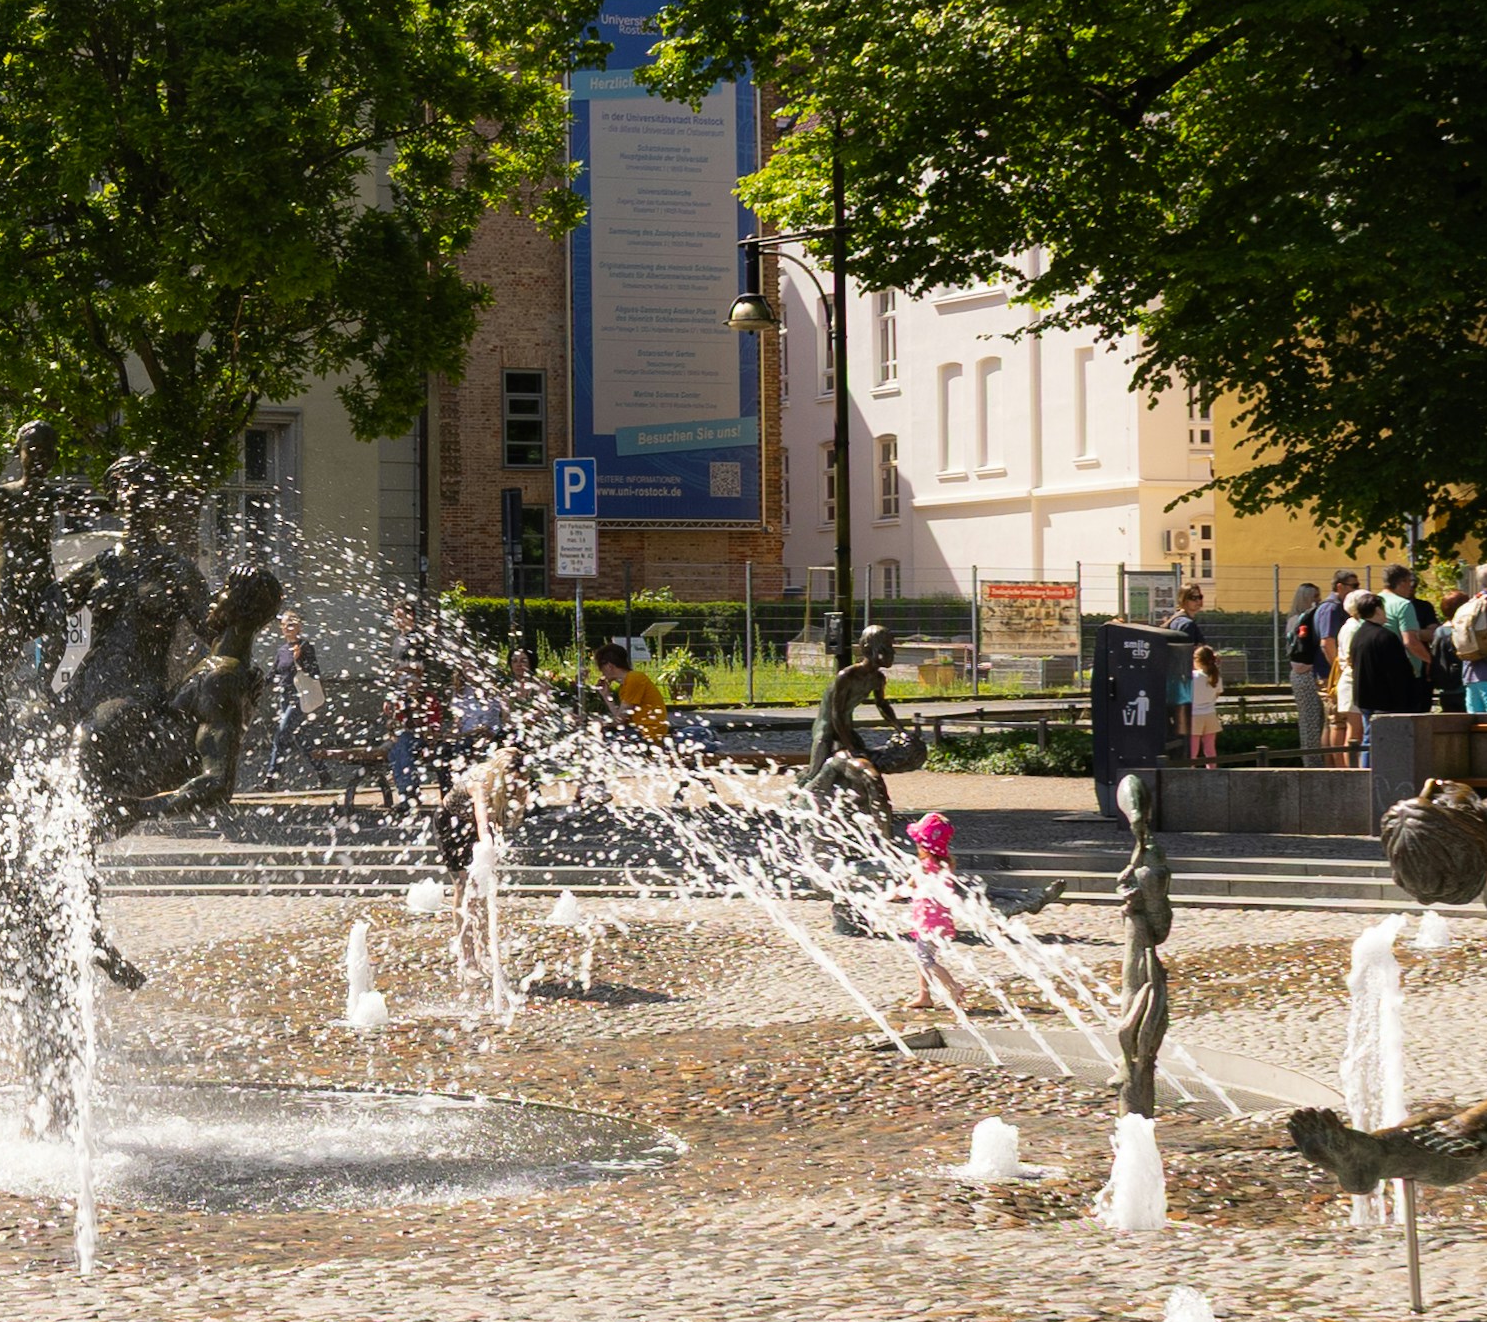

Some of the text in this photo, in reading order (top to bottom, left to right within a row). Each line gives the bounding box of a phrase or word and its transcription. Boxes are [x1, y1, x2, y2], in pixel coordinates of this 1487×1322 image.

[611, 111, 625, 121] der
[626, 112, 691, 125] Universitätsstadt
[693, 116, 725, 127] Rostock
[637, 424, 742, 445] Besuchen Sie uns!
[563, 466, 587, 510] P
[1123, 639, 1151, 649] smile
